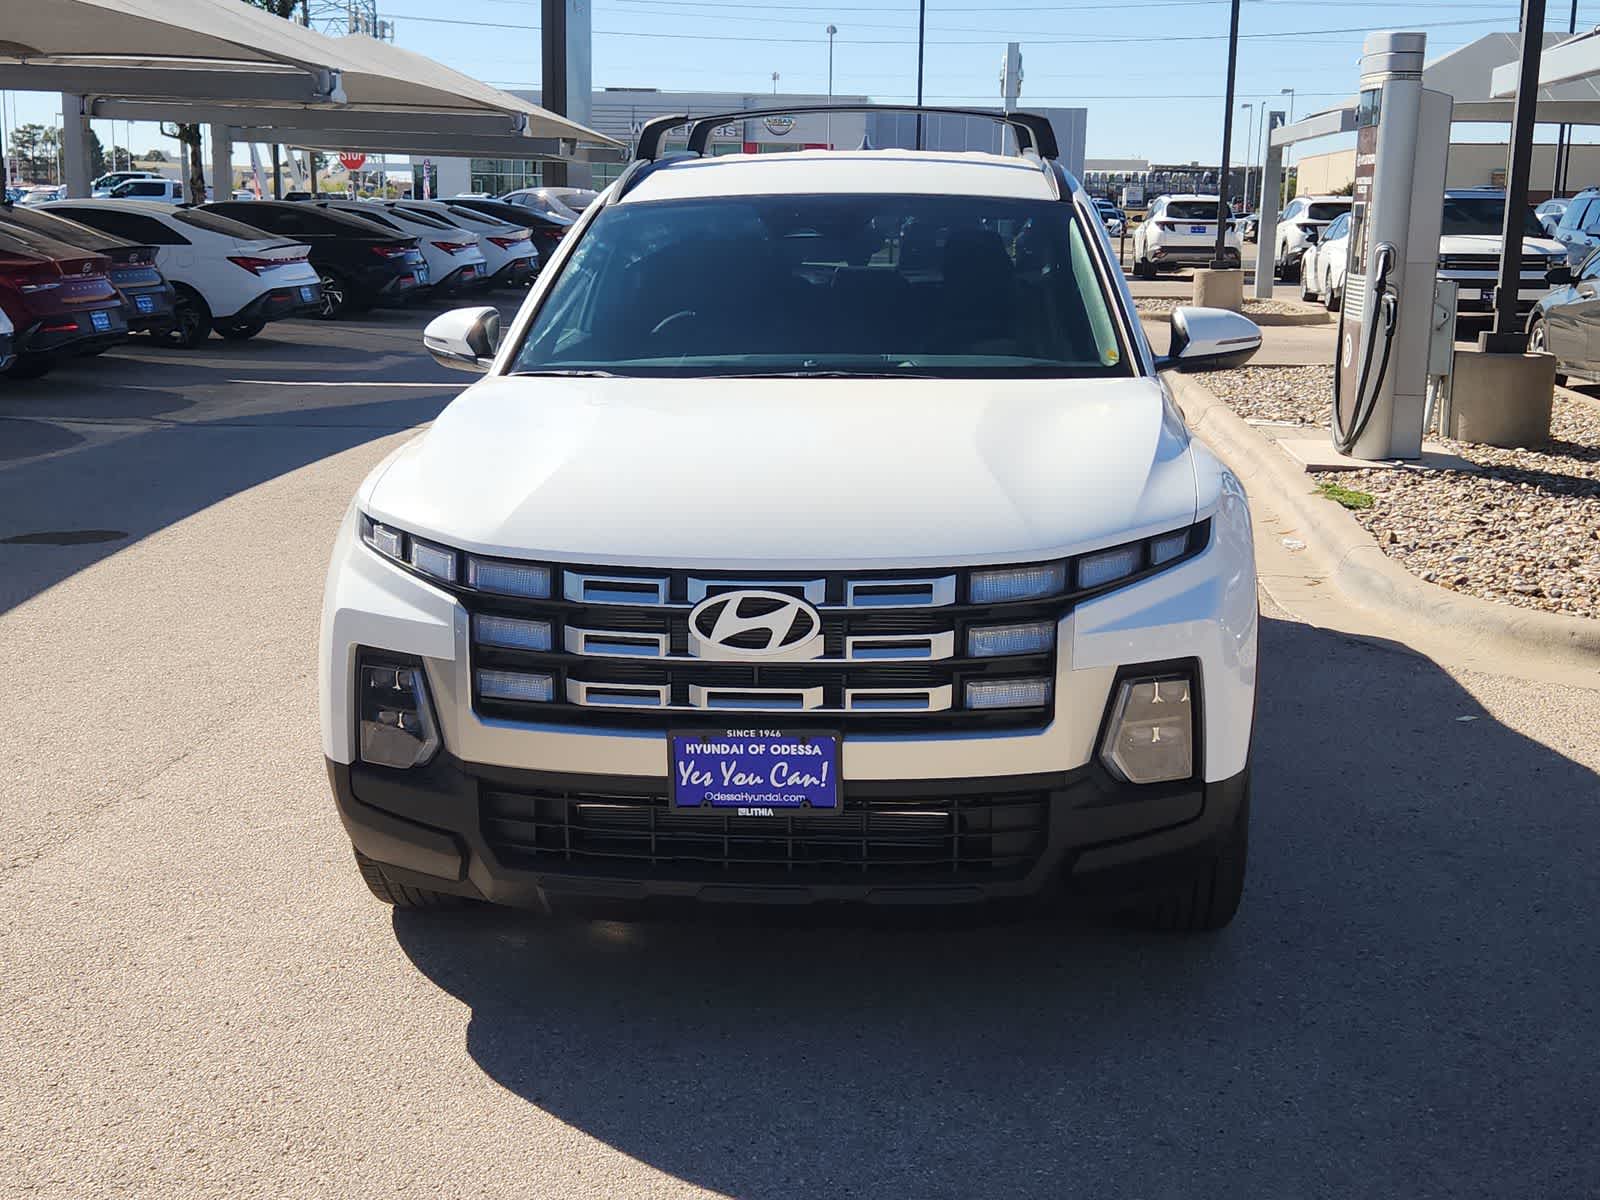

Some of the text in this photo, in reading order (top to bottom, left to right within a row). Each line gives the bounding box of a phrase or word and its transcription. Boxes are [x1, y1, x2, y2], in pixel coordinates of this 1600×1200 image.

[341, 151, 364, 161] STOP
[686, 744, 822, 756] HYUNDAI OF ODESSA
[678, 760, 829, 788] Yes You Can!
[704, 792, 806, 803] OdessaHyundai.com
[746, 808, 774, 816] LITHIA
